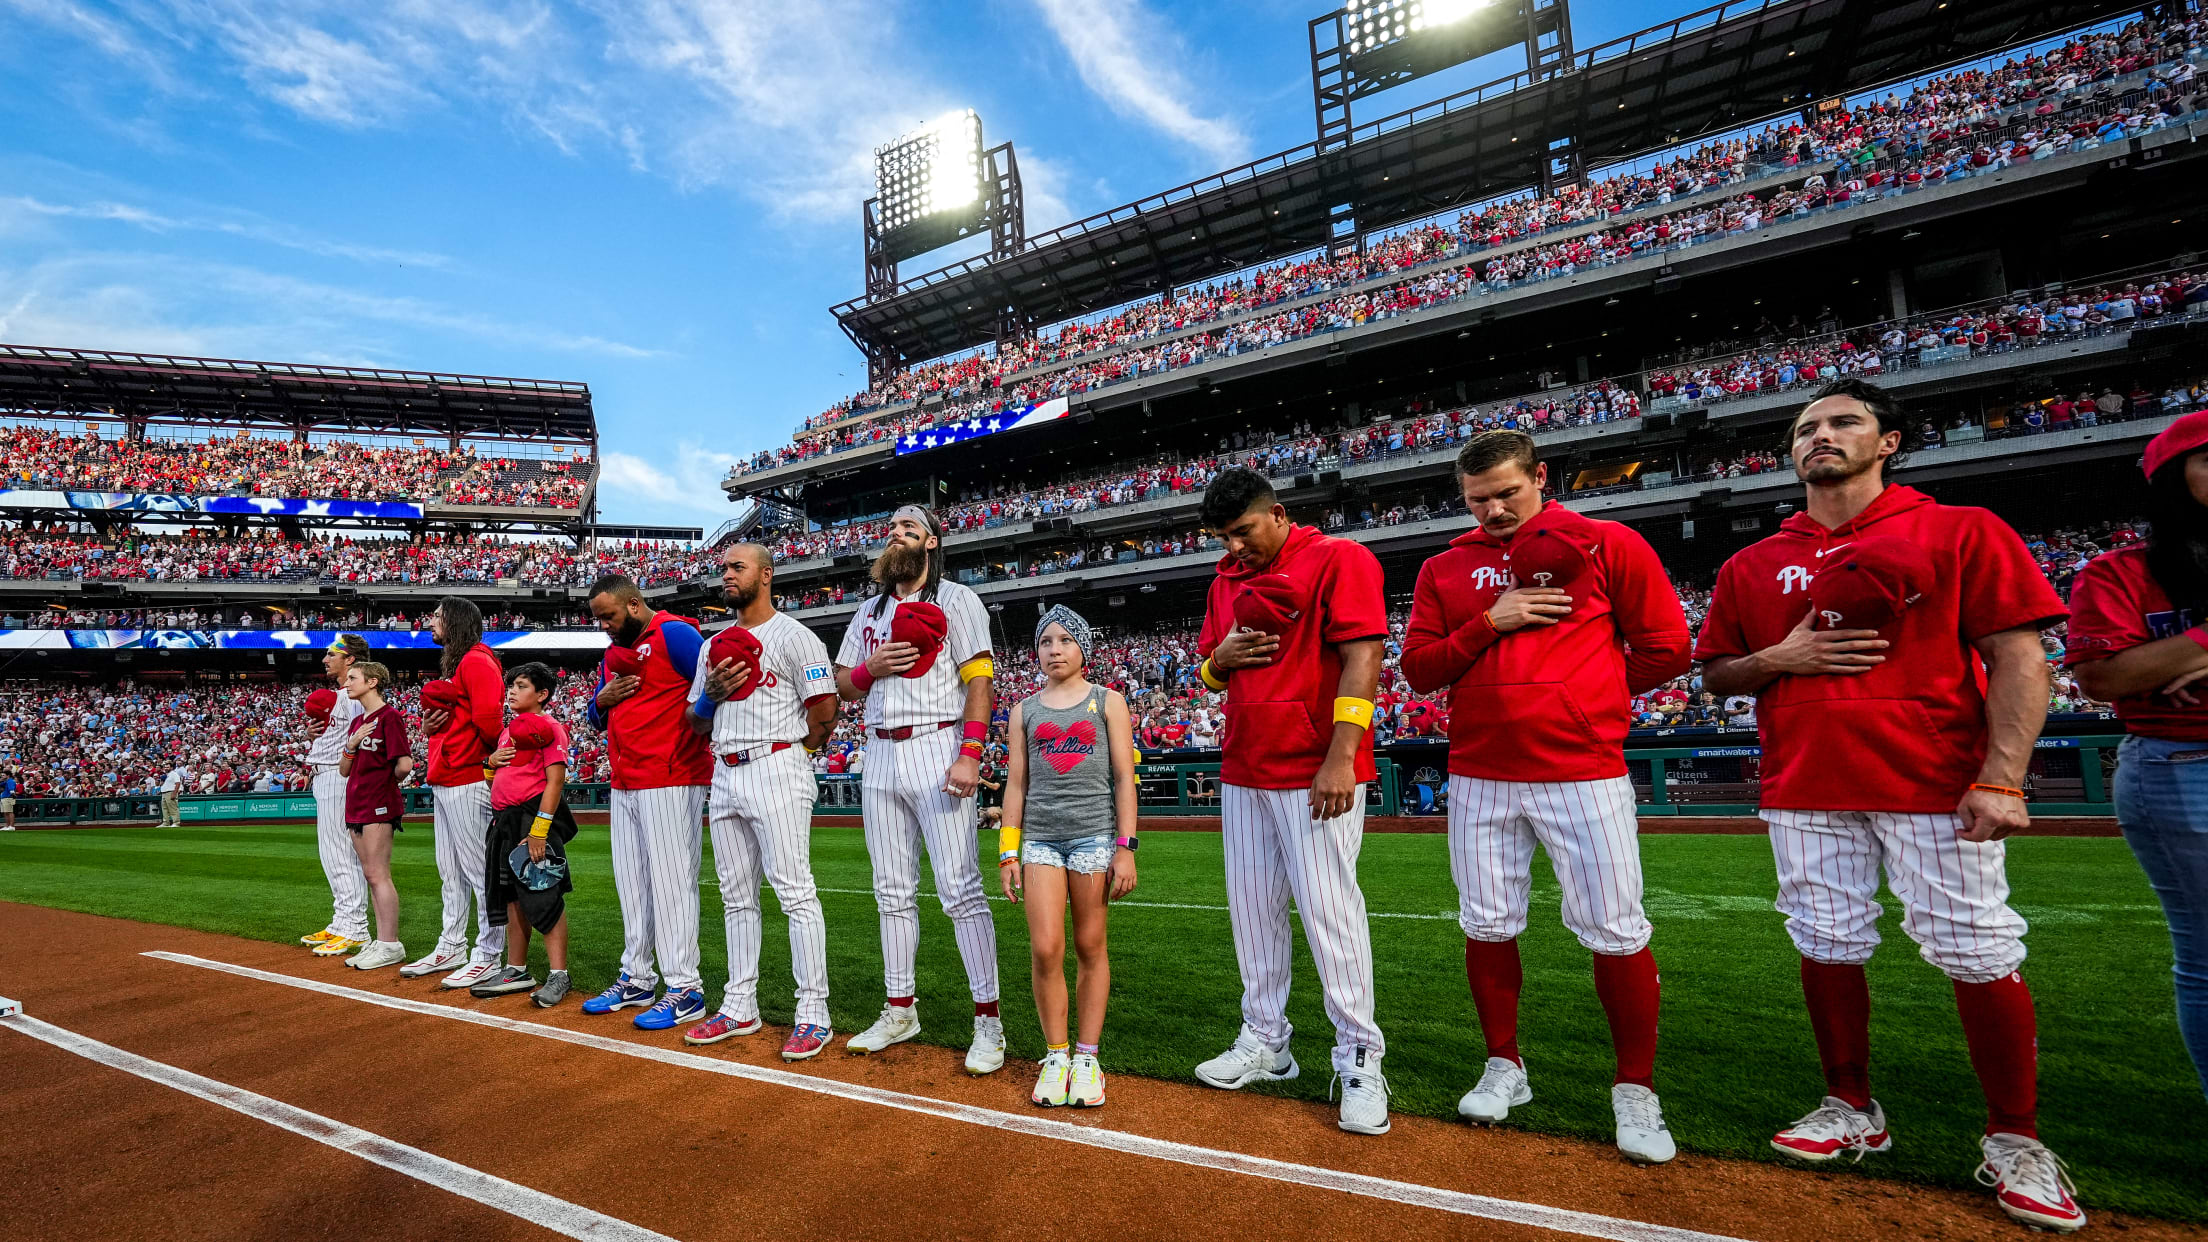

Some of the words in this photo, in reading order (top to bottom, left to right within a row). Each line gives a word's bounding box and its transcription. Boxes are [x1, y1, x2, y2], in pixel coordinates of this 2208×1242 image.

[1533, 572, 1552, 587] P
[1820, 610, 1843, 628] P
[805, 667, 829, 680] IBX
[1037, 736, 1094, 758] Phillies
[1698, 749, 1751, 757] smartwater
[738, 751, 747, 760] 33
[1665, 771, 1708, 779] Citizens
